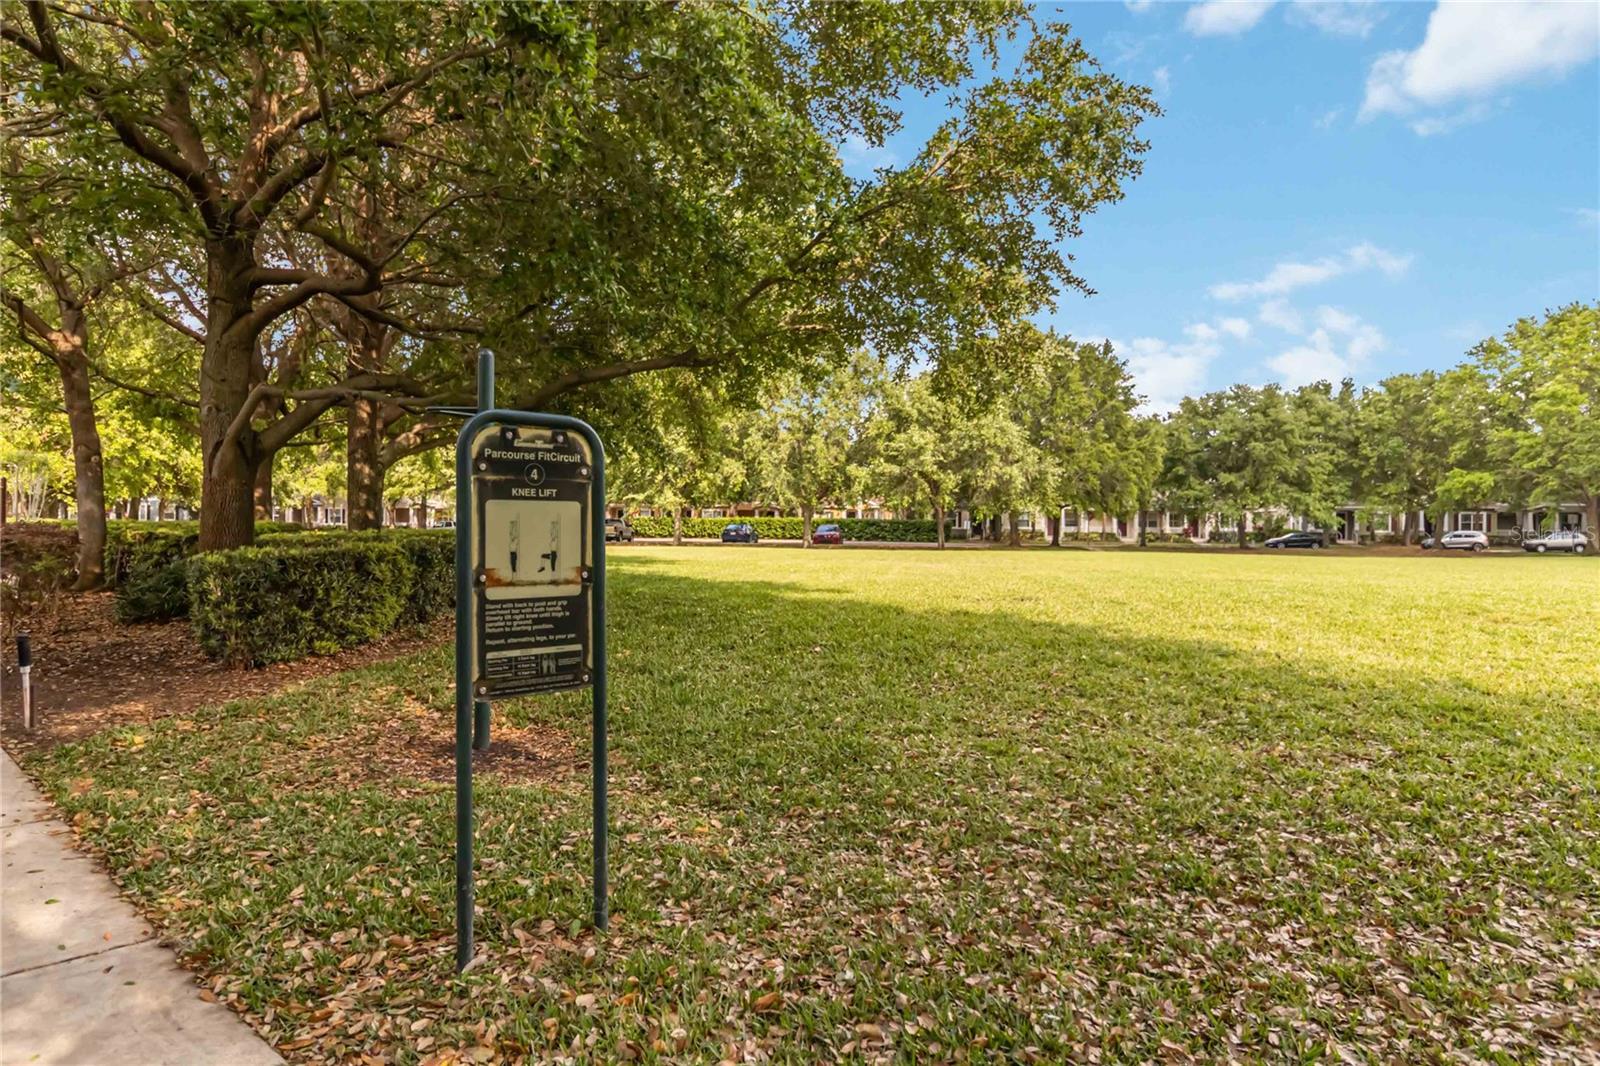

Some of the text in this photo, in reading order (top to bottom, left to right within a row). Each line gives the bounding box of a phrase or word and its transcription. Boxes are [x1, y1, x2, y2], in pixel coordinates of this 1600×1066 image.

[485, 448, 581, 462] Parcourse FitCircuit
[531, 469, 537, 480] 4
[512, 488, 557, 497] KNEE LIFT
